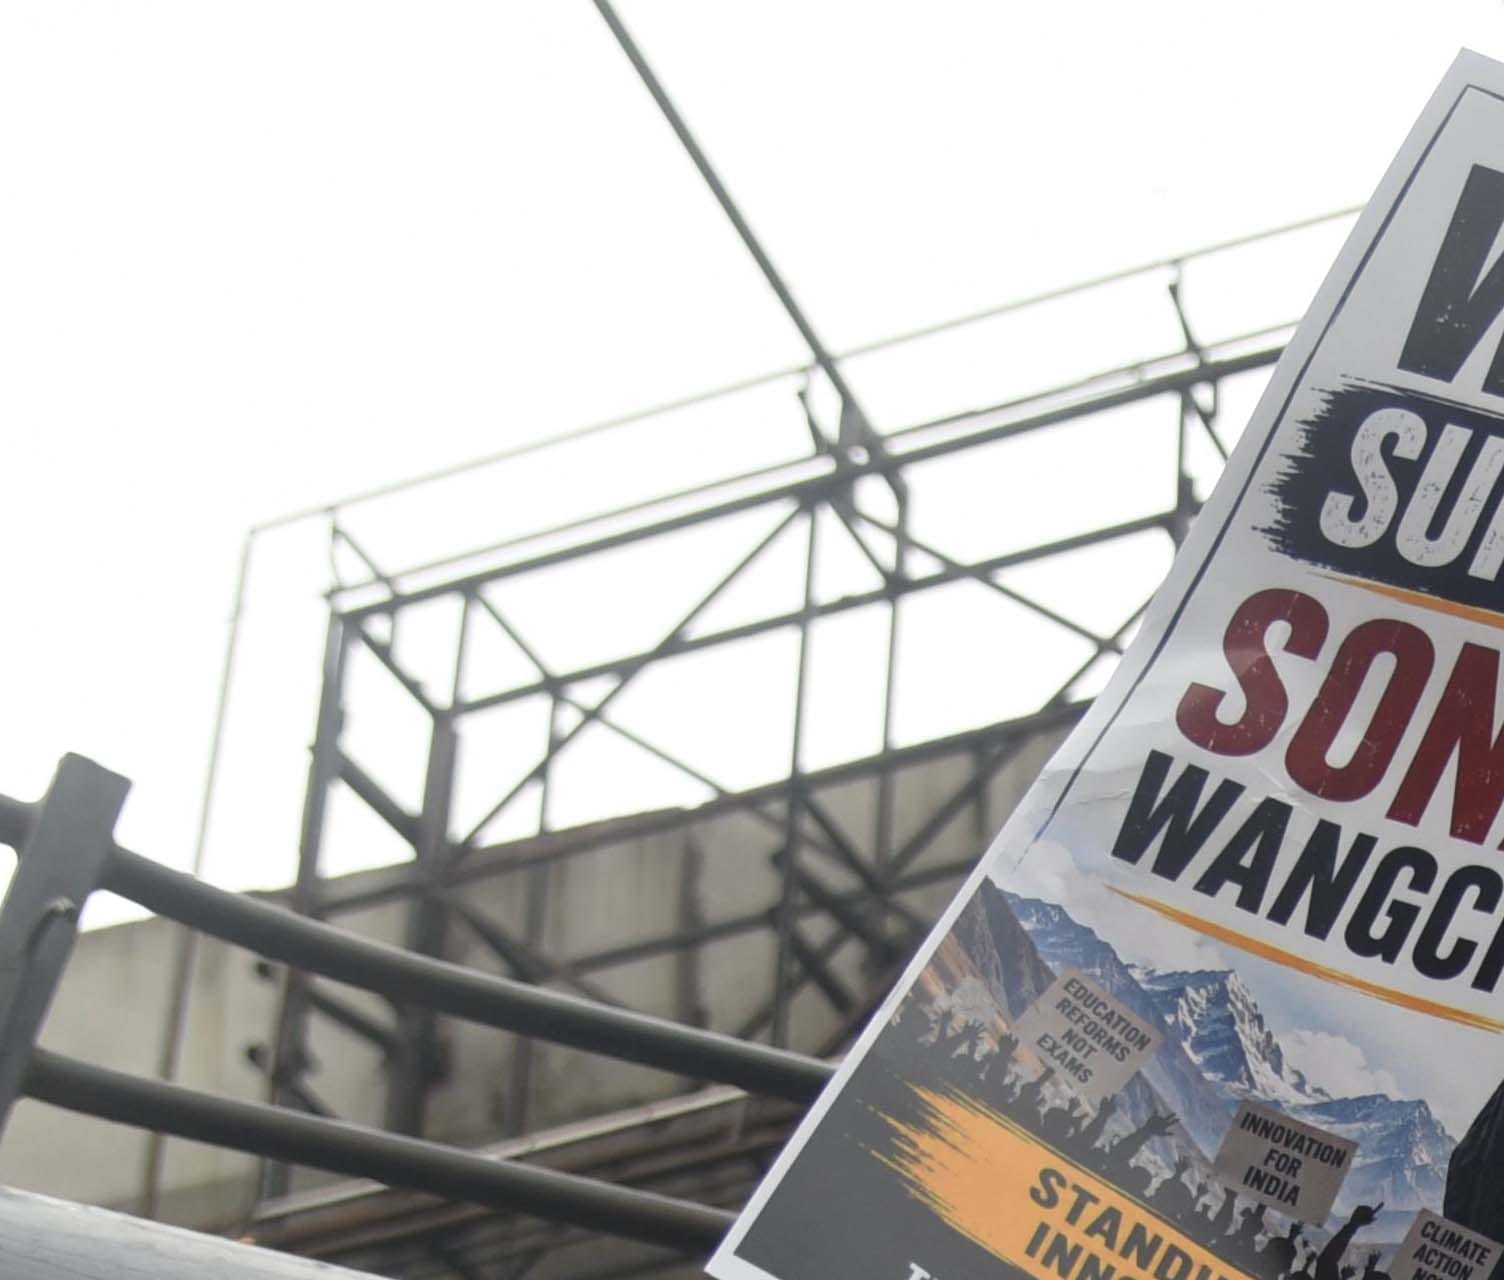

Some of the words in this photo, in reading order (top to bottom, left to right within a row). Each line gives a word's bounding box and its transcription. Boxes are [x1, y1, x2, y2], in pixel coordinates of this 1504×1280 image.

[1056, 998, 1130, 1062] REFORMS
[1063, 977, 1151, 1052] EDUCATION
[1036, 1032, 1094, 1085] EXAMS
[1061, 1028, 1099, 1057] NOT
[1239, 1111, 1347, 1169] INNOVATION
[1263, 1148, 1302, 1176] FOR
[1243, 1168, 1301, 1207] INDIA
[1420, 1221, 1491, 1266] CLIMATE
